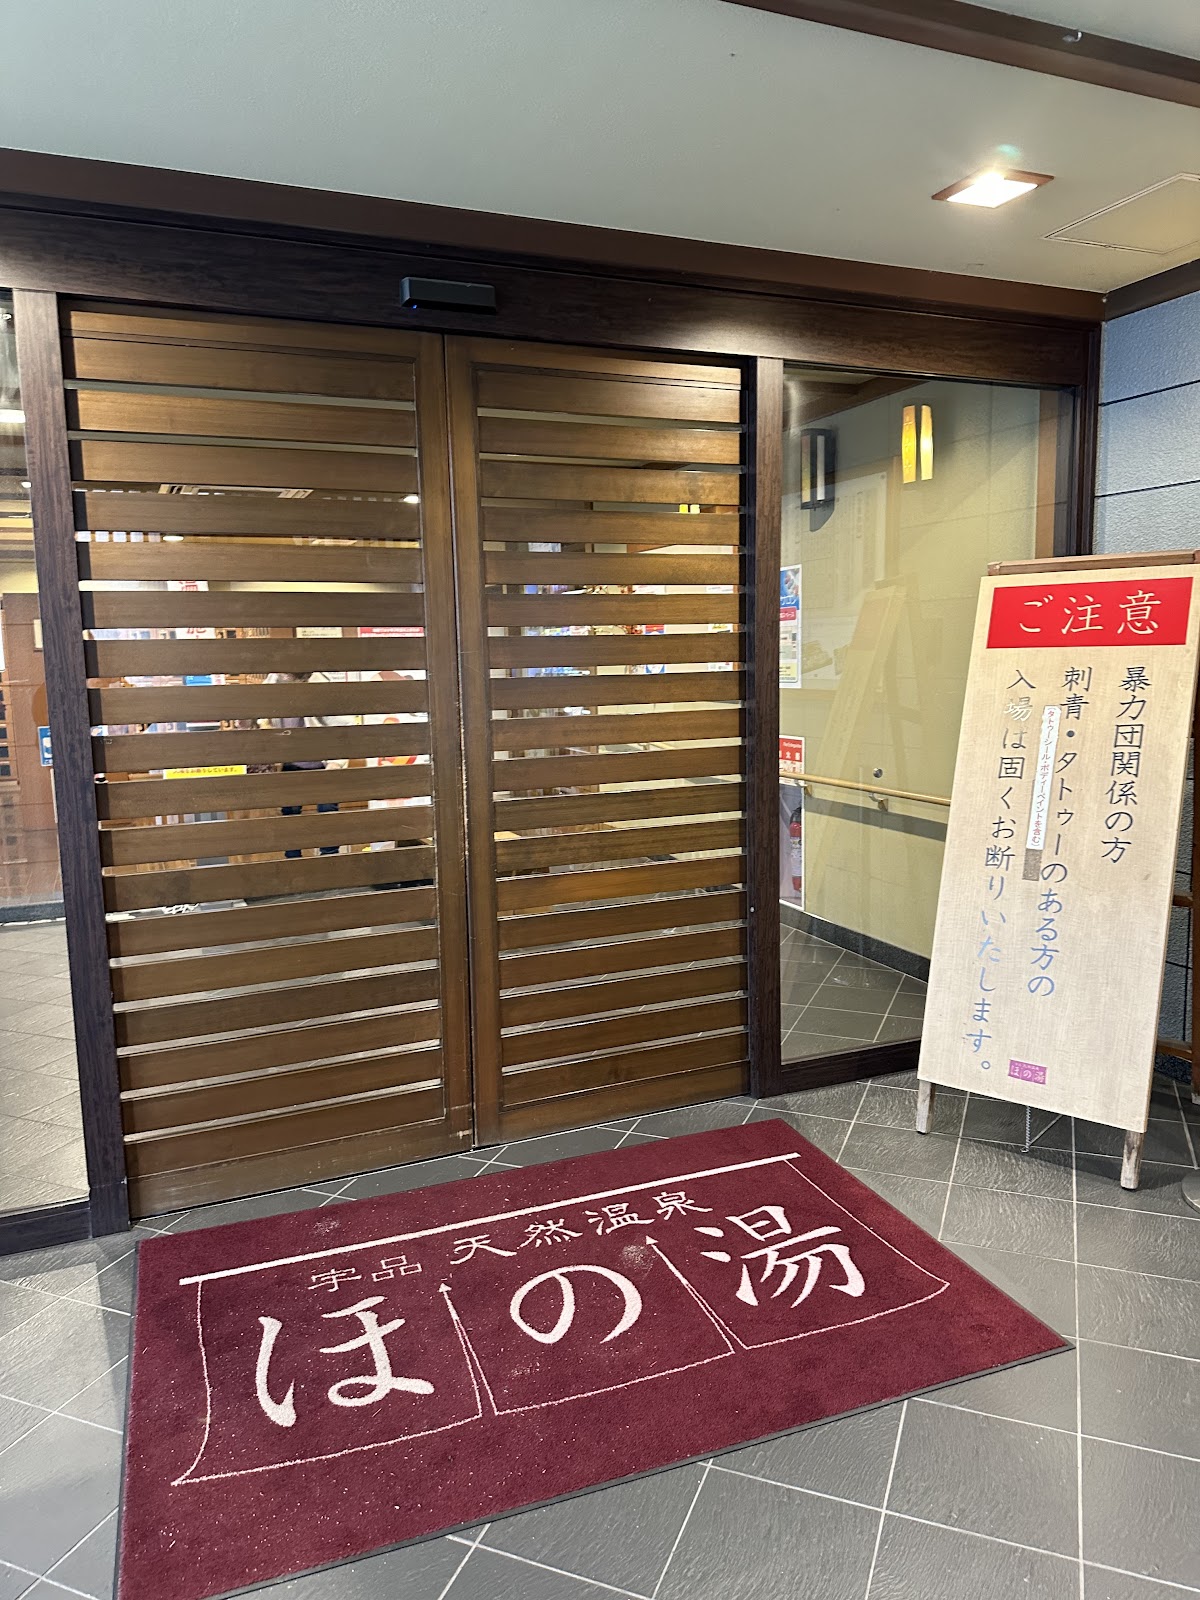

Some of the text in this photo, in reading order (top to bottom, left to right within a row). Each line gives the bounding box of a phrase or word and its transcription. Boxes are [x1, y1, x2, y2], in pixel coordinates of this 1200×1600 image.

[1018, 589, 1162, 635] ご注意
[965, 669, 1036, 1070] 入場は固くお断りいたします。
[1027, 666, 1093, 996] 刺青・タトゥーのある方の
[1101, 666, 1151, 864] 暴力団関係の方
[254, 1205, 867, 1427] ほの湯
[307, 1191, 713, 1292] 宇品 天然温泉
